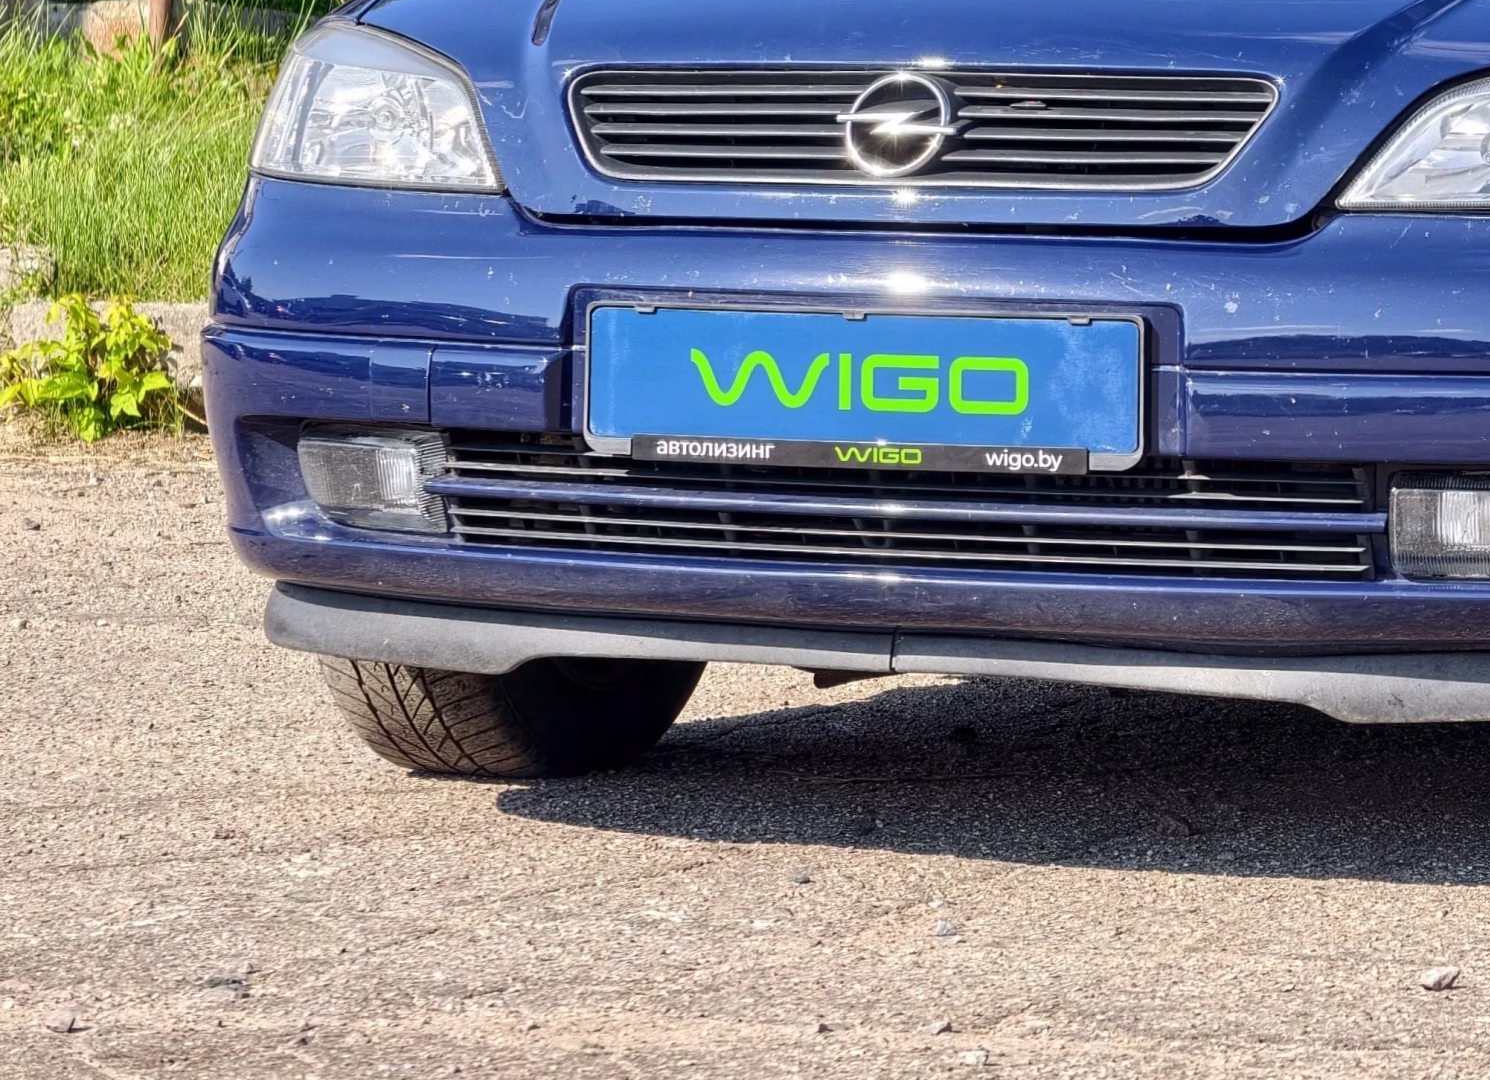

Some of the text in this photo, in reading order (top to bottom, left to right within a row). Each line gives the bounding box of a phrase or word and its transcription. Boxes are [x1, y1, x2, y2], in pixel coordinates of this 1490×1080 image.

[690, 348, 1029, 415] WIGO
[657, 440, 775, 458] автолизинг
[834, 446, 922, 464] WIGO
[985, 447, 1063, 472] wigo.by
